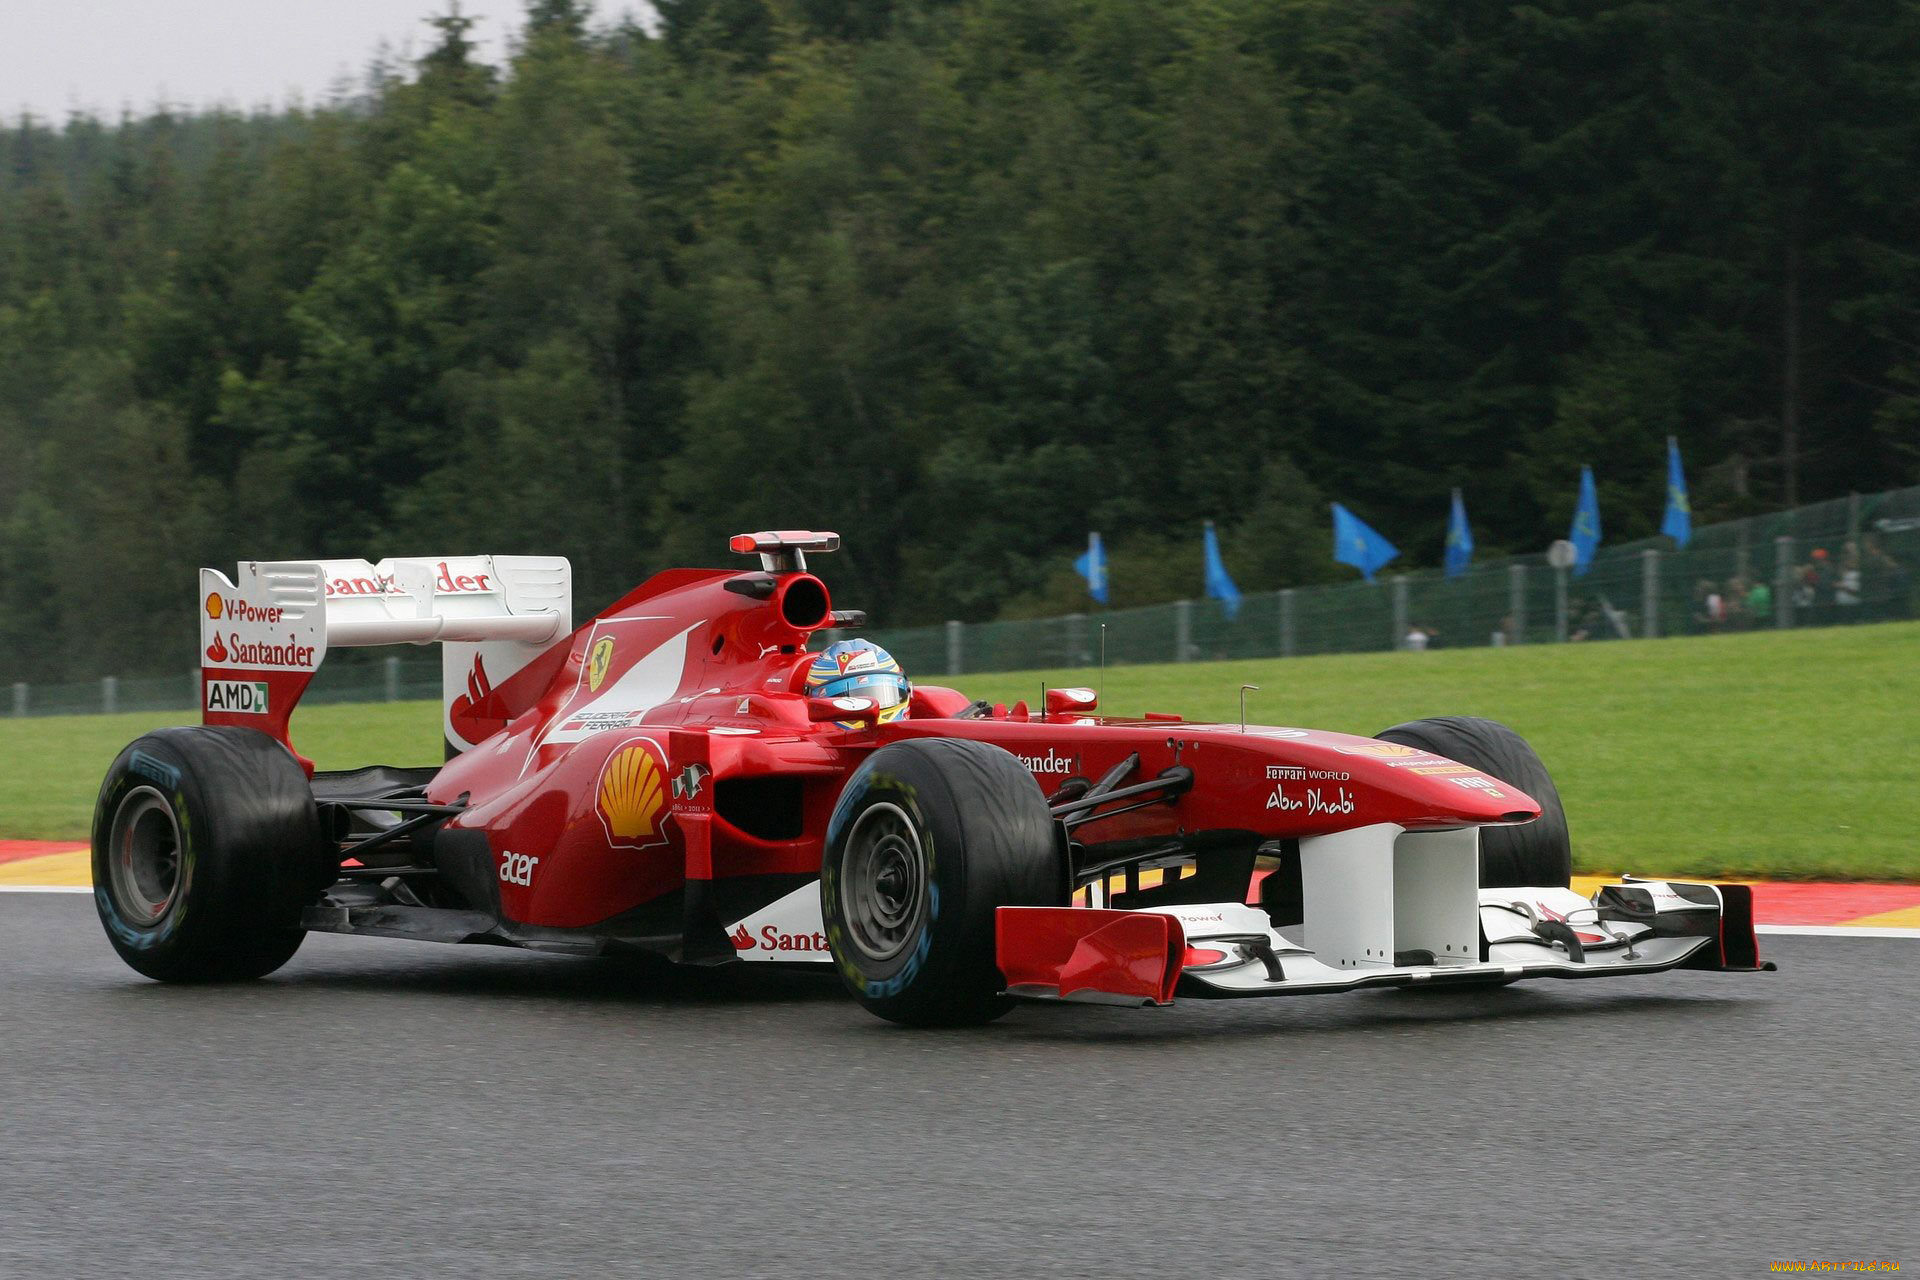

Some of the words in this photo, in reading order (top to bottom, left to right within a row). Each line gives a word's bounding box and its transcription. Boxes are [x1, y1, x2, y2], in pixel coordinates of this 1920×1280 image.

[225, 599, 284, 623] V-Power
[230, 633, 315, 667] Santander
[208, 683, 253, 710] AMD
[1266, 765, 1306, 781] Ferrari
[1309, 770, 1350, 781] WORLD
[1266, 783, 1303, 811] Abu
[1307, 786, 1355, 816] Dhabi
[500, 850, 539, 887] acer
